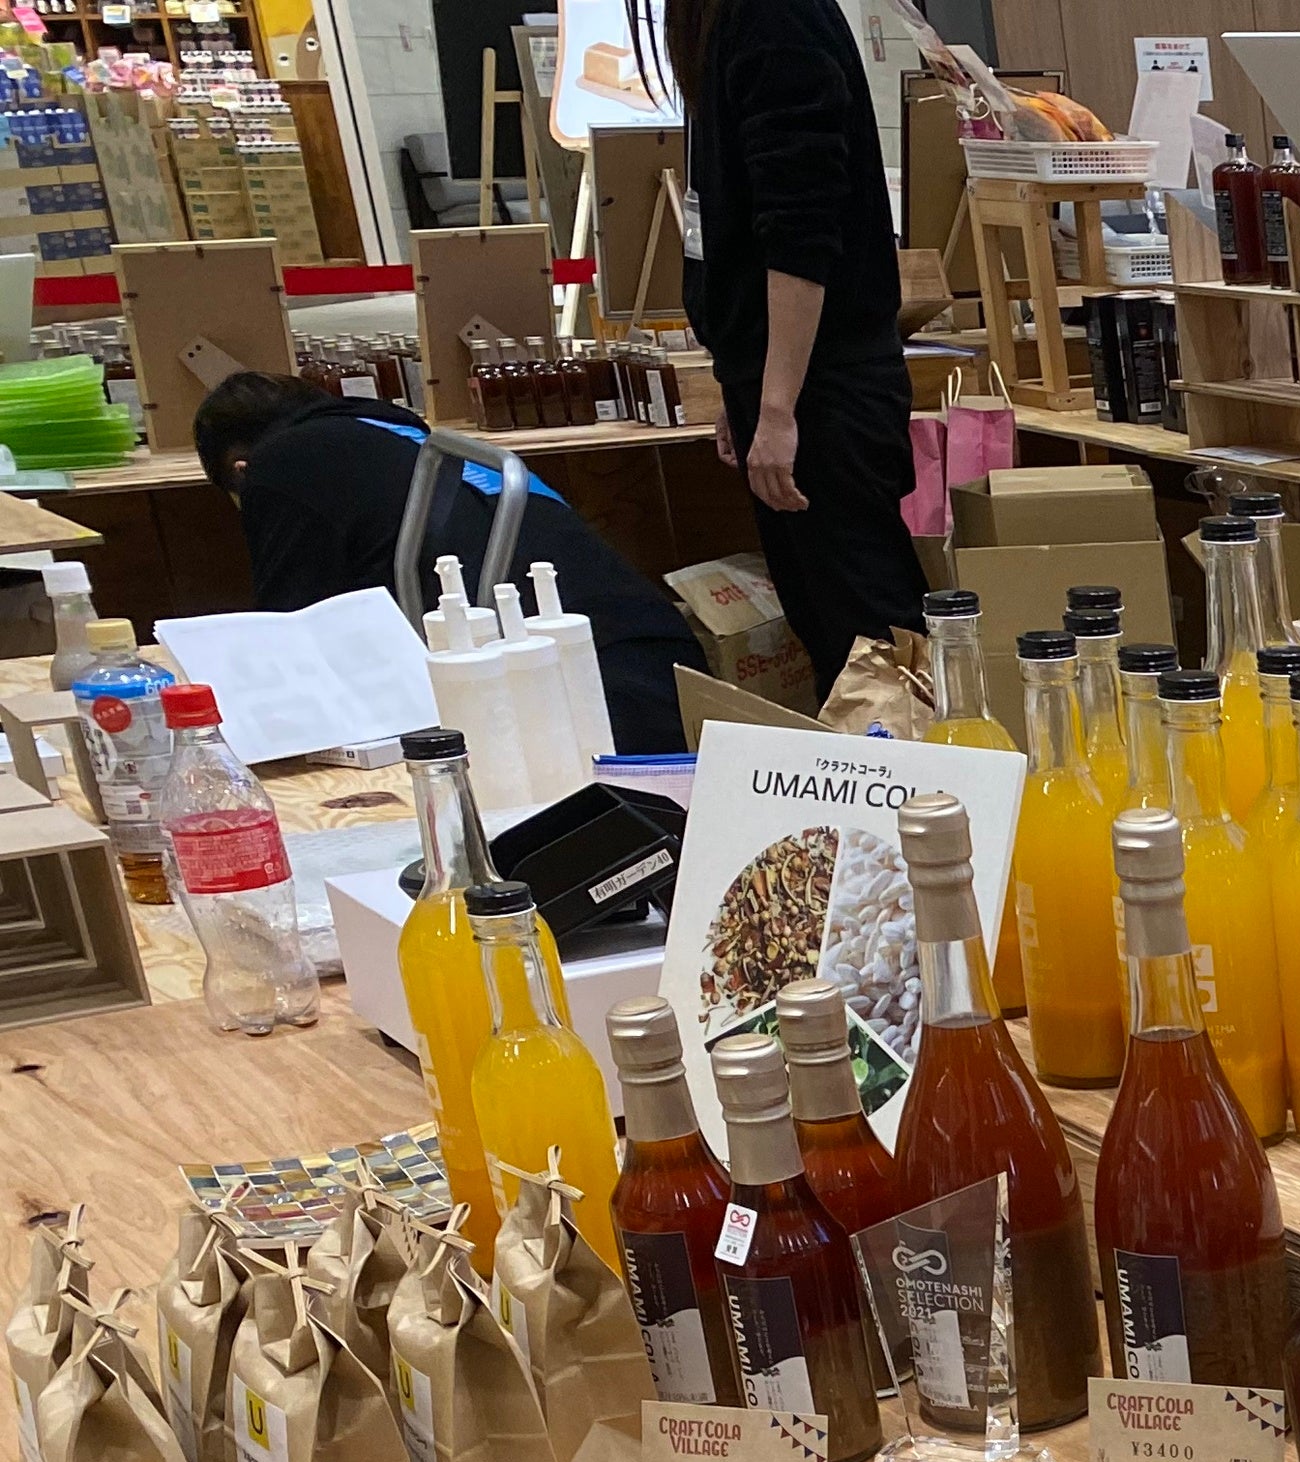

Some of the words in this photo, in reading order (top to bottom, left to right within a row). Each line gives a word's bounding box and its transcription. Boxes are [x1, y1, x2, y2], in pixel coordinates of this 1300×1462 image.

[752, 769, 858, 805] UMAMI
[591, 850, 671, 902] 有明ガーデン40
[624, 1247, 649, 1326] UMAMI
[896, 1277, 983, 1298] OMOTENASHI
[897, 1289, 984, 1312] SELECTION
[1117, 1268, 1137, 1348] UMAMI
[728, 1294, 752, 1375] UMAMI
[1106, 1392, 1154, 1415] CRAFT
[1156, 1395, 1194, 1415] COLA
[249, 1400, 264, 1435] U
[658, 1416, 702, 1437] CRAFT
[704, 1420, 742, 1441] COLA
[1119, 1410, 1182, 1431] VILLAGE
[670, 1434, 729, 1458] VILLAGE
[1131, 1440, 1194, 1460] ¥3400
